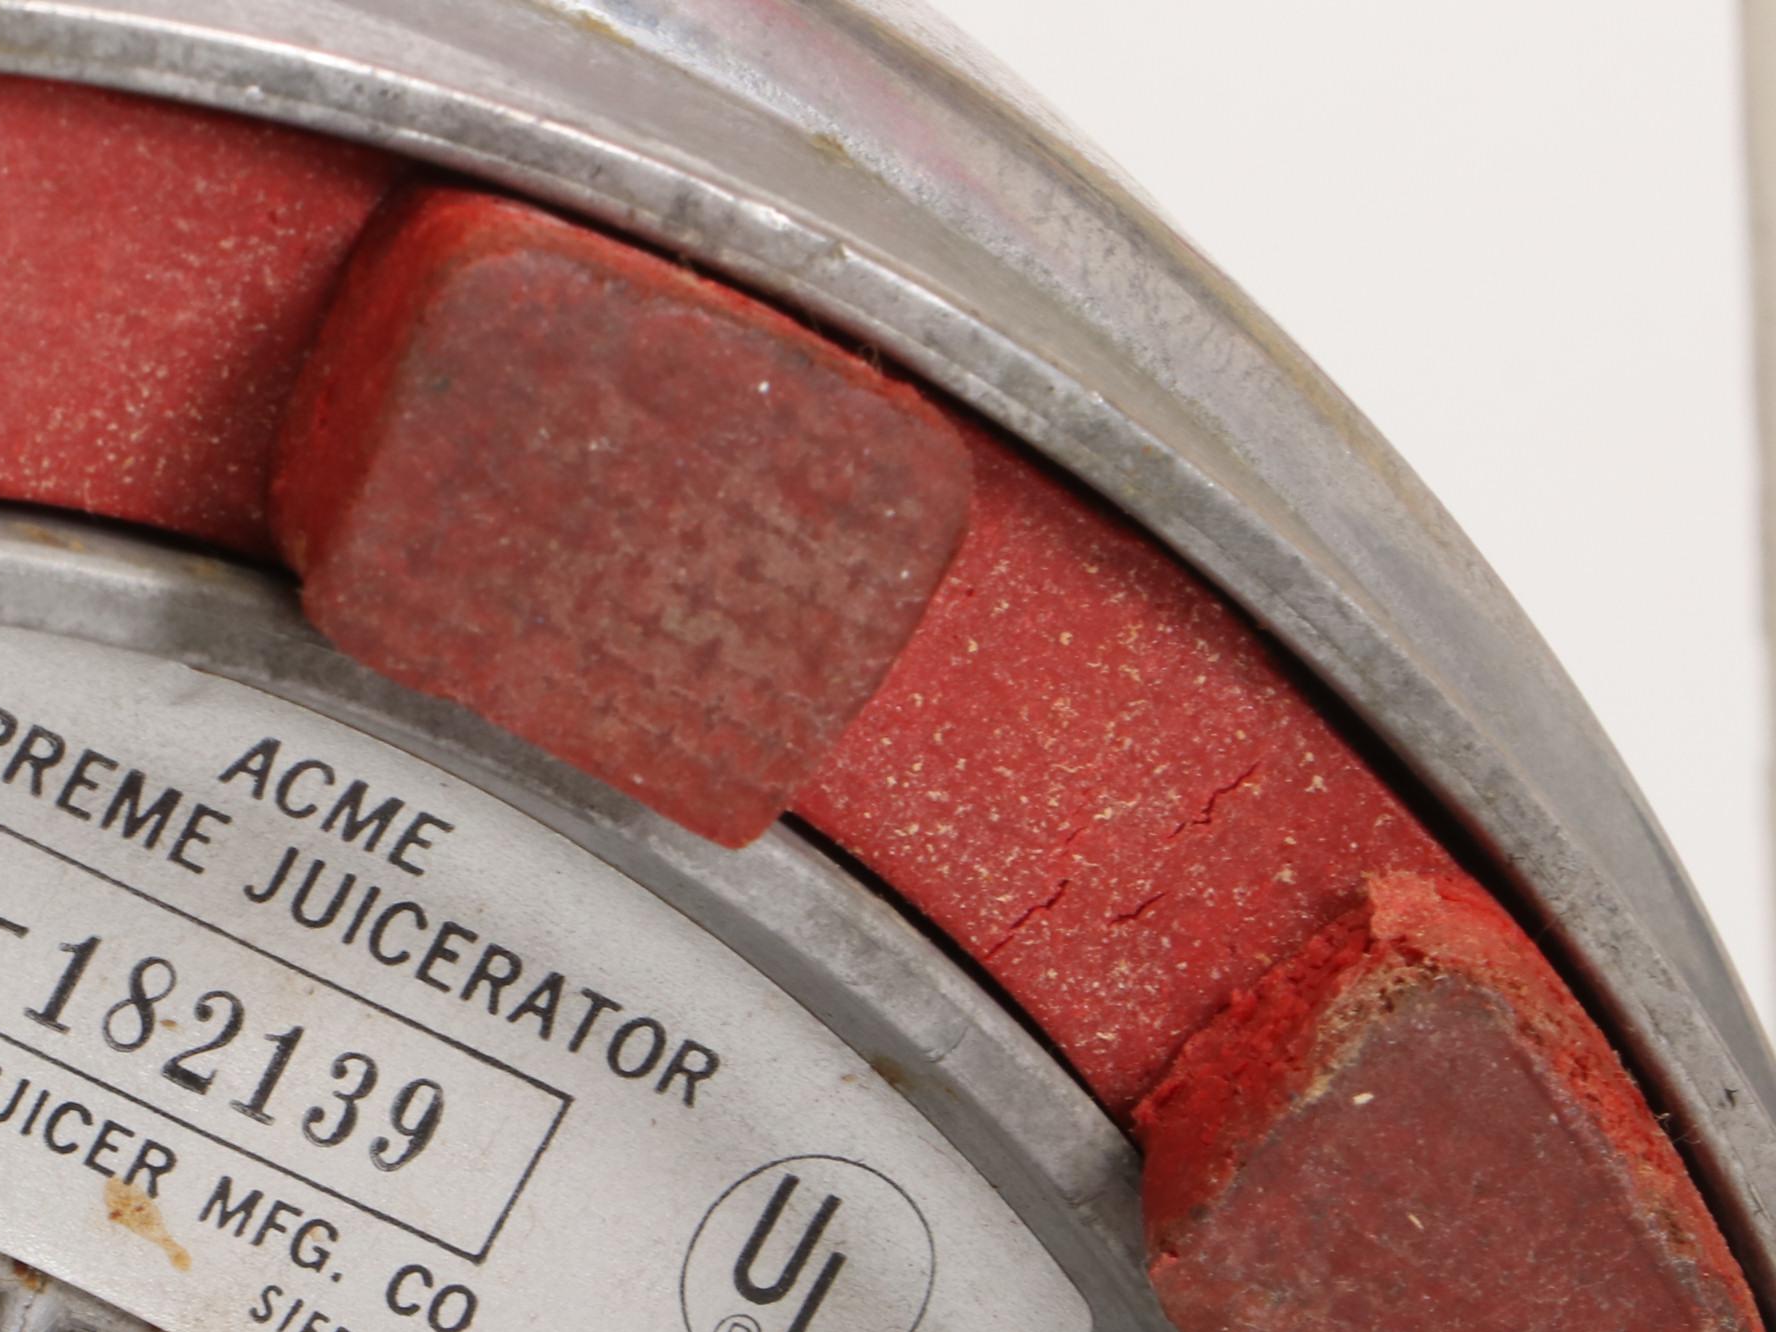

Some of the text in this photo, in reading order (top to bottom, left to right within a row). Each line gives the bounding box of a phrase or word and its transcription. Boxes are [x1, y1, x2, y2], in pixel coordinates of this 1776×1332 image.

[217, 737, 455, 877] ACME
[243, 846, 722, 1110] JUICERATOR
[198, 1175, 343, 1283] MFG.
